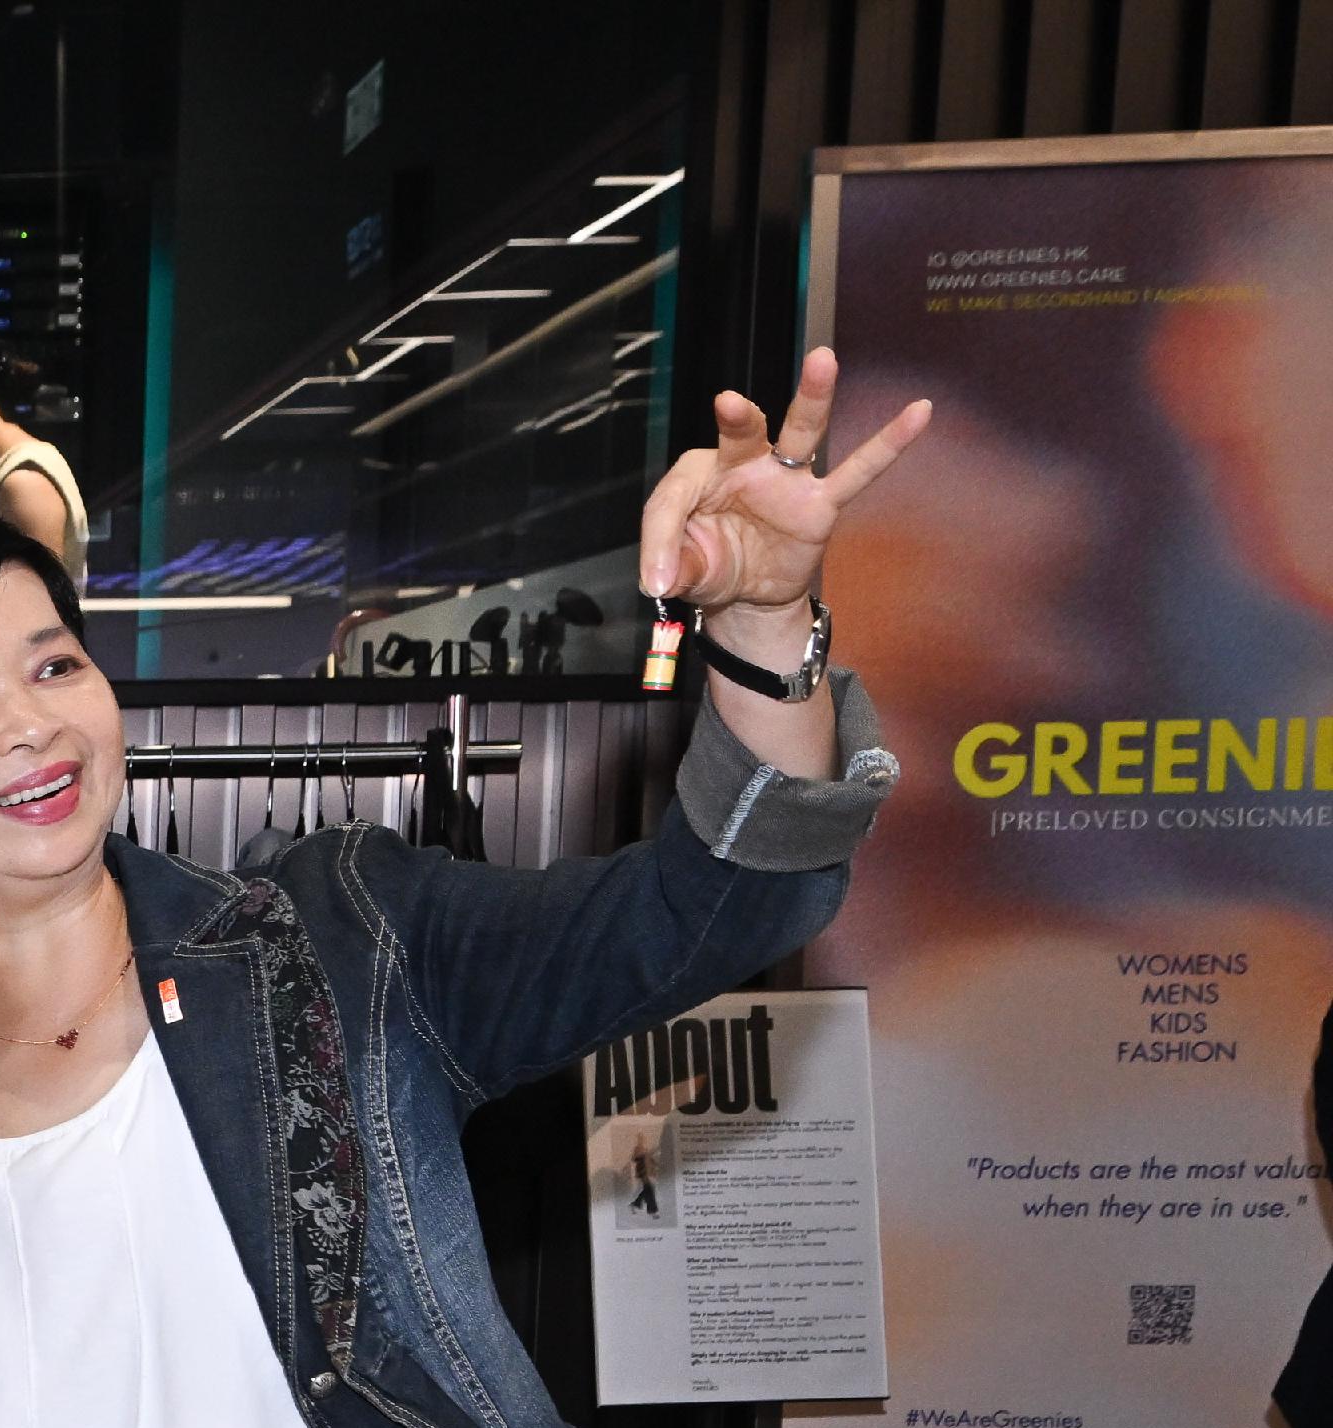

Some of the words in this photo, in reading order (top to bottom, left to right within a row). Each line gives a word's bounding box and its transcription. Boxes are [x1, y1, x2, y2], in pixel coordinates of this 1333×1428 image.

[1117, 953, 1248, 976] WOMENS
[1141, 983, 1219, 1005] MENS
[1150, 1012, 1207, 1034] KIDS
[1117, 1041, 1237, 1062] FASHION
[968, 1157, 1081, 1180] "Products
[1089, 1163, 1131, 1180] are
[1140, 1156, 1177, 1180] the
[1186, 1160, 1247, 1180] most
[1023, 1194, 1089, 1218] when
[1099, 1194, 1151, 1224] they
[1160, 1200, 1201, 1218] are
[1210, 1197, 1232, 1218] in
[1242, 1196, 1308, 1218] use."
